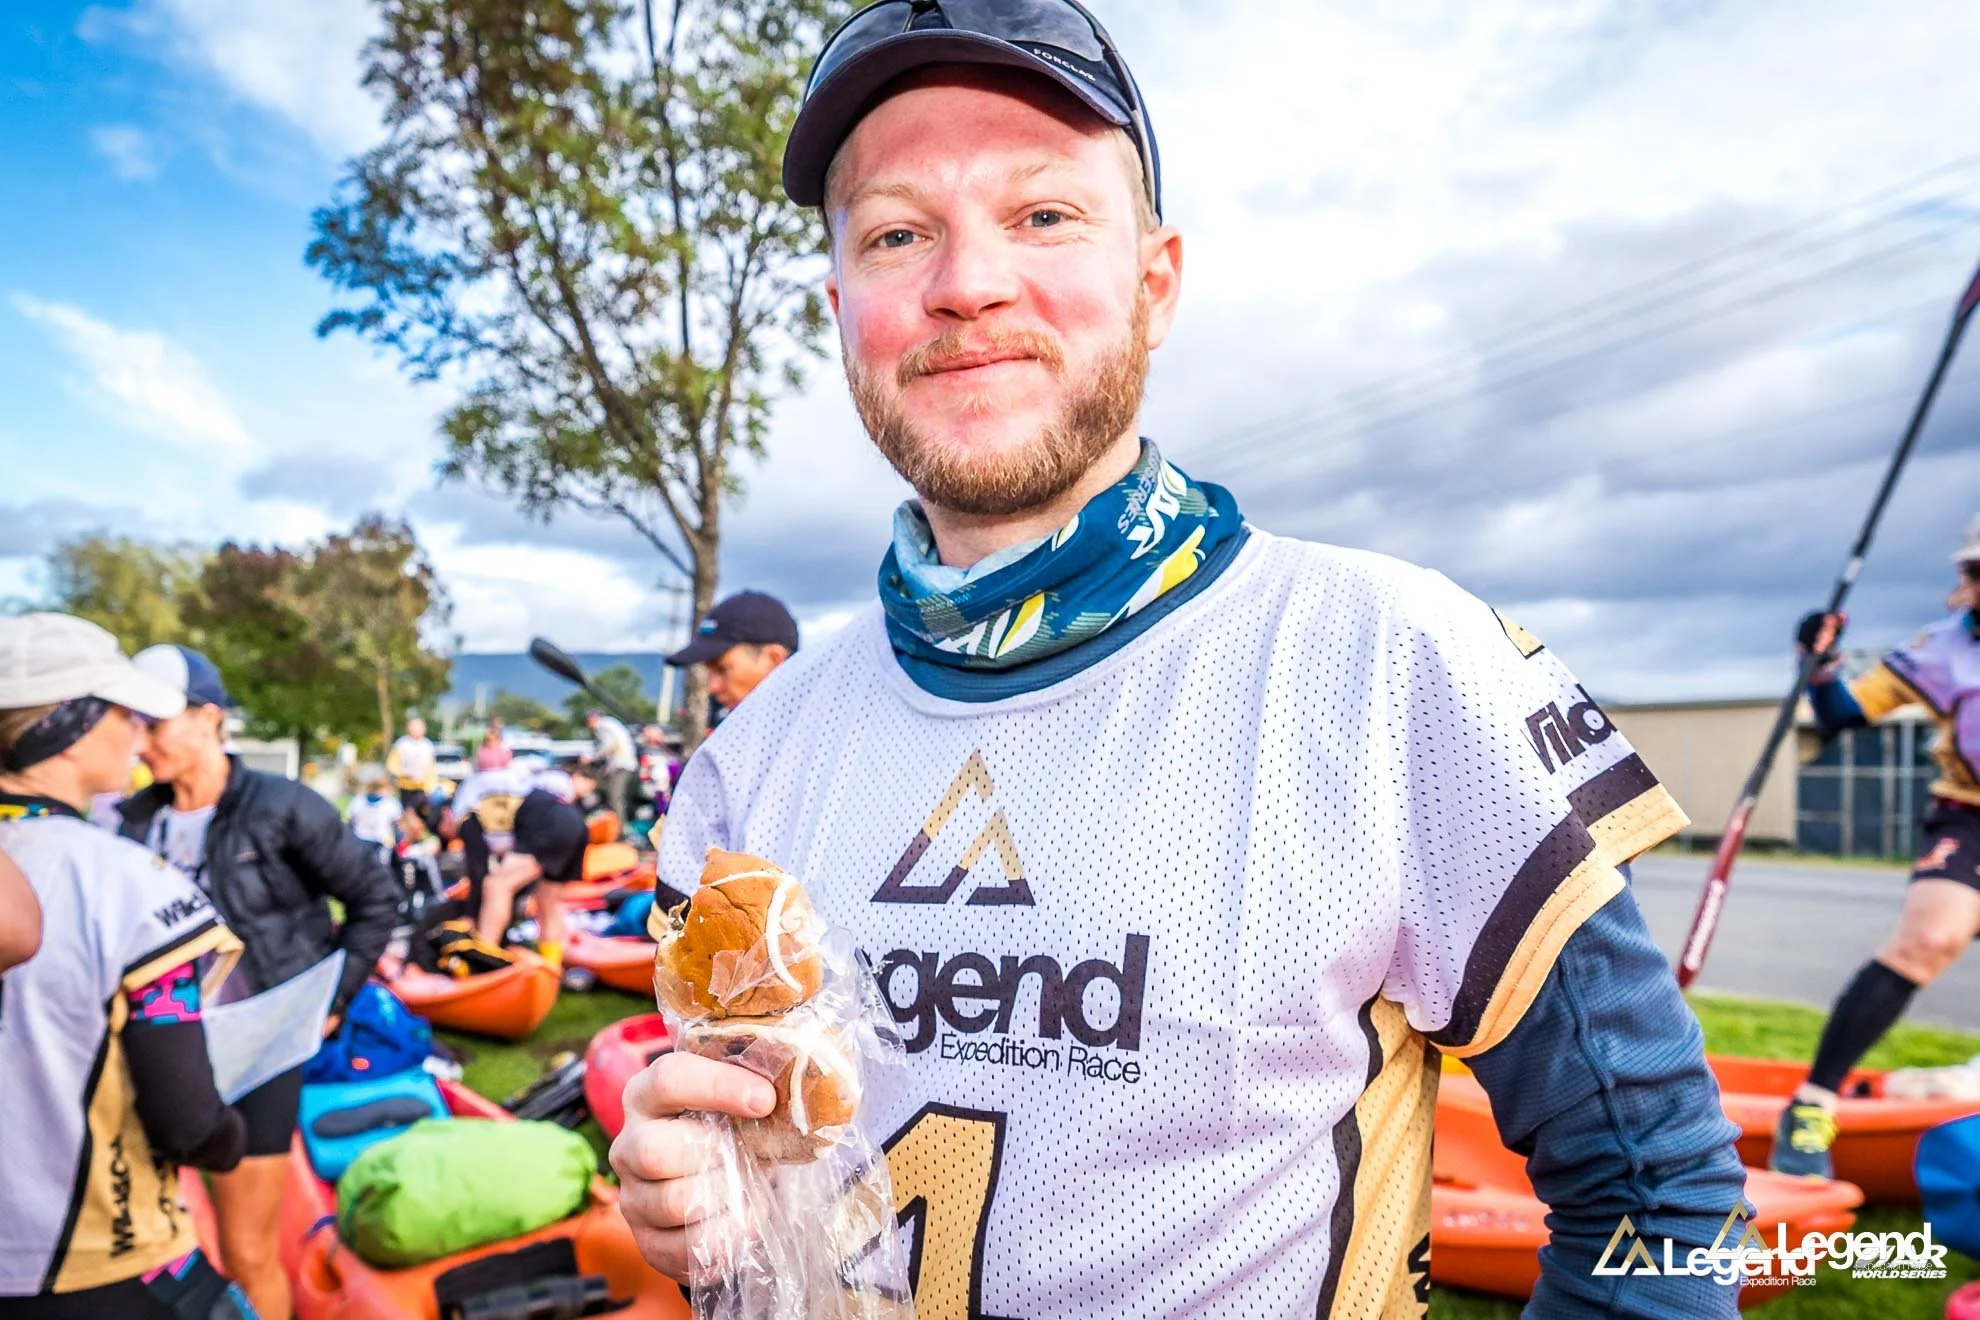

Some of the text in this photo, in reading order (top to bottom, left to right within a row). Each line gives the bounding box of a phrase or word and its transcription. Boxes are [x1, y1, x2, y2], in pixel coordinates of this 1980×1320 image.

[860, 933, 1150, 1054] gend
[941, 1033, 1141, 1084] Expedition Race
